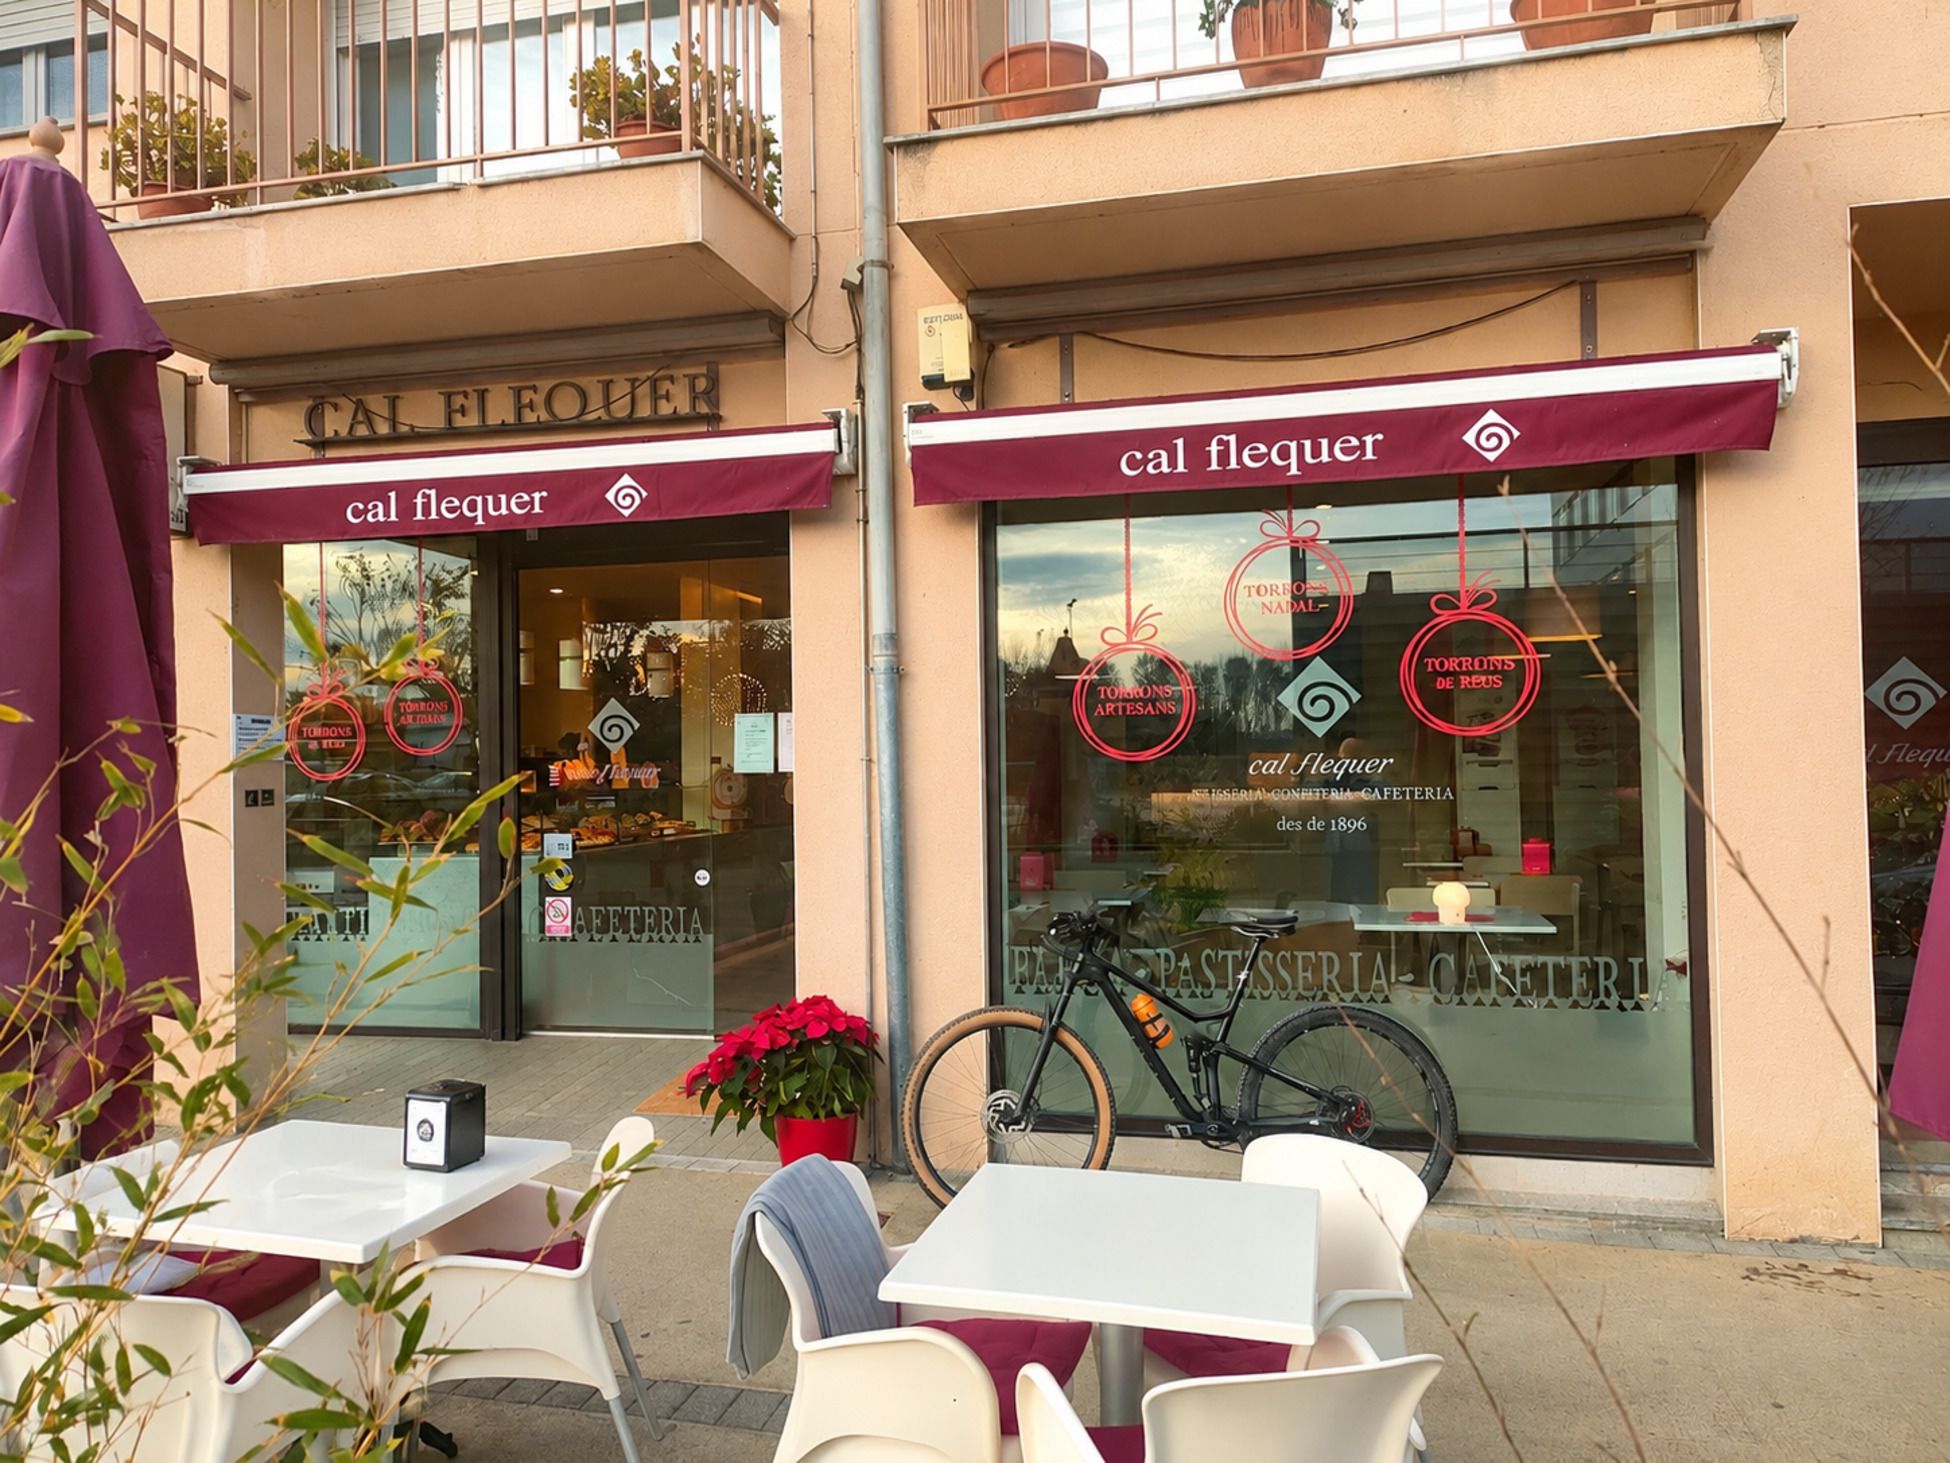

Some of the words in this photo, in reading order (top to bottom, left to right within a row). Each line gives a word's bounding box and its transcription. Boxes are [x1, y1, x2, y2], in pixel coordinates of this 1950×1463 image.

[304, 392, 413, 439] CAL
[1119, 437, 1189, 477] cal
[1205, 432, 1385, 477] flequer
[346, 490, 400, 524] cal
[412, 488, 548, 526] flequer
[1261, 598, 1320, 615] NADAL
[1424, 655, 1516, 673] TORRONS
[1436, 677, 1455, 690] DE
[1460, 674, 1503, 689] REUS
[1097, 684, 1173, 700] TORRONS
[1094, 700, 1177, 716] ARTESANS
[1248, 752, 1291, 776] cal
[1290, 752, 1394, 781] flequer
[1360, 786, 1454, 801] CAFETERIA
[1276, 815, 1303, 832] des
[1306, 815, 1326, 832] de
[1330, 816, 1367, 834] 1896
